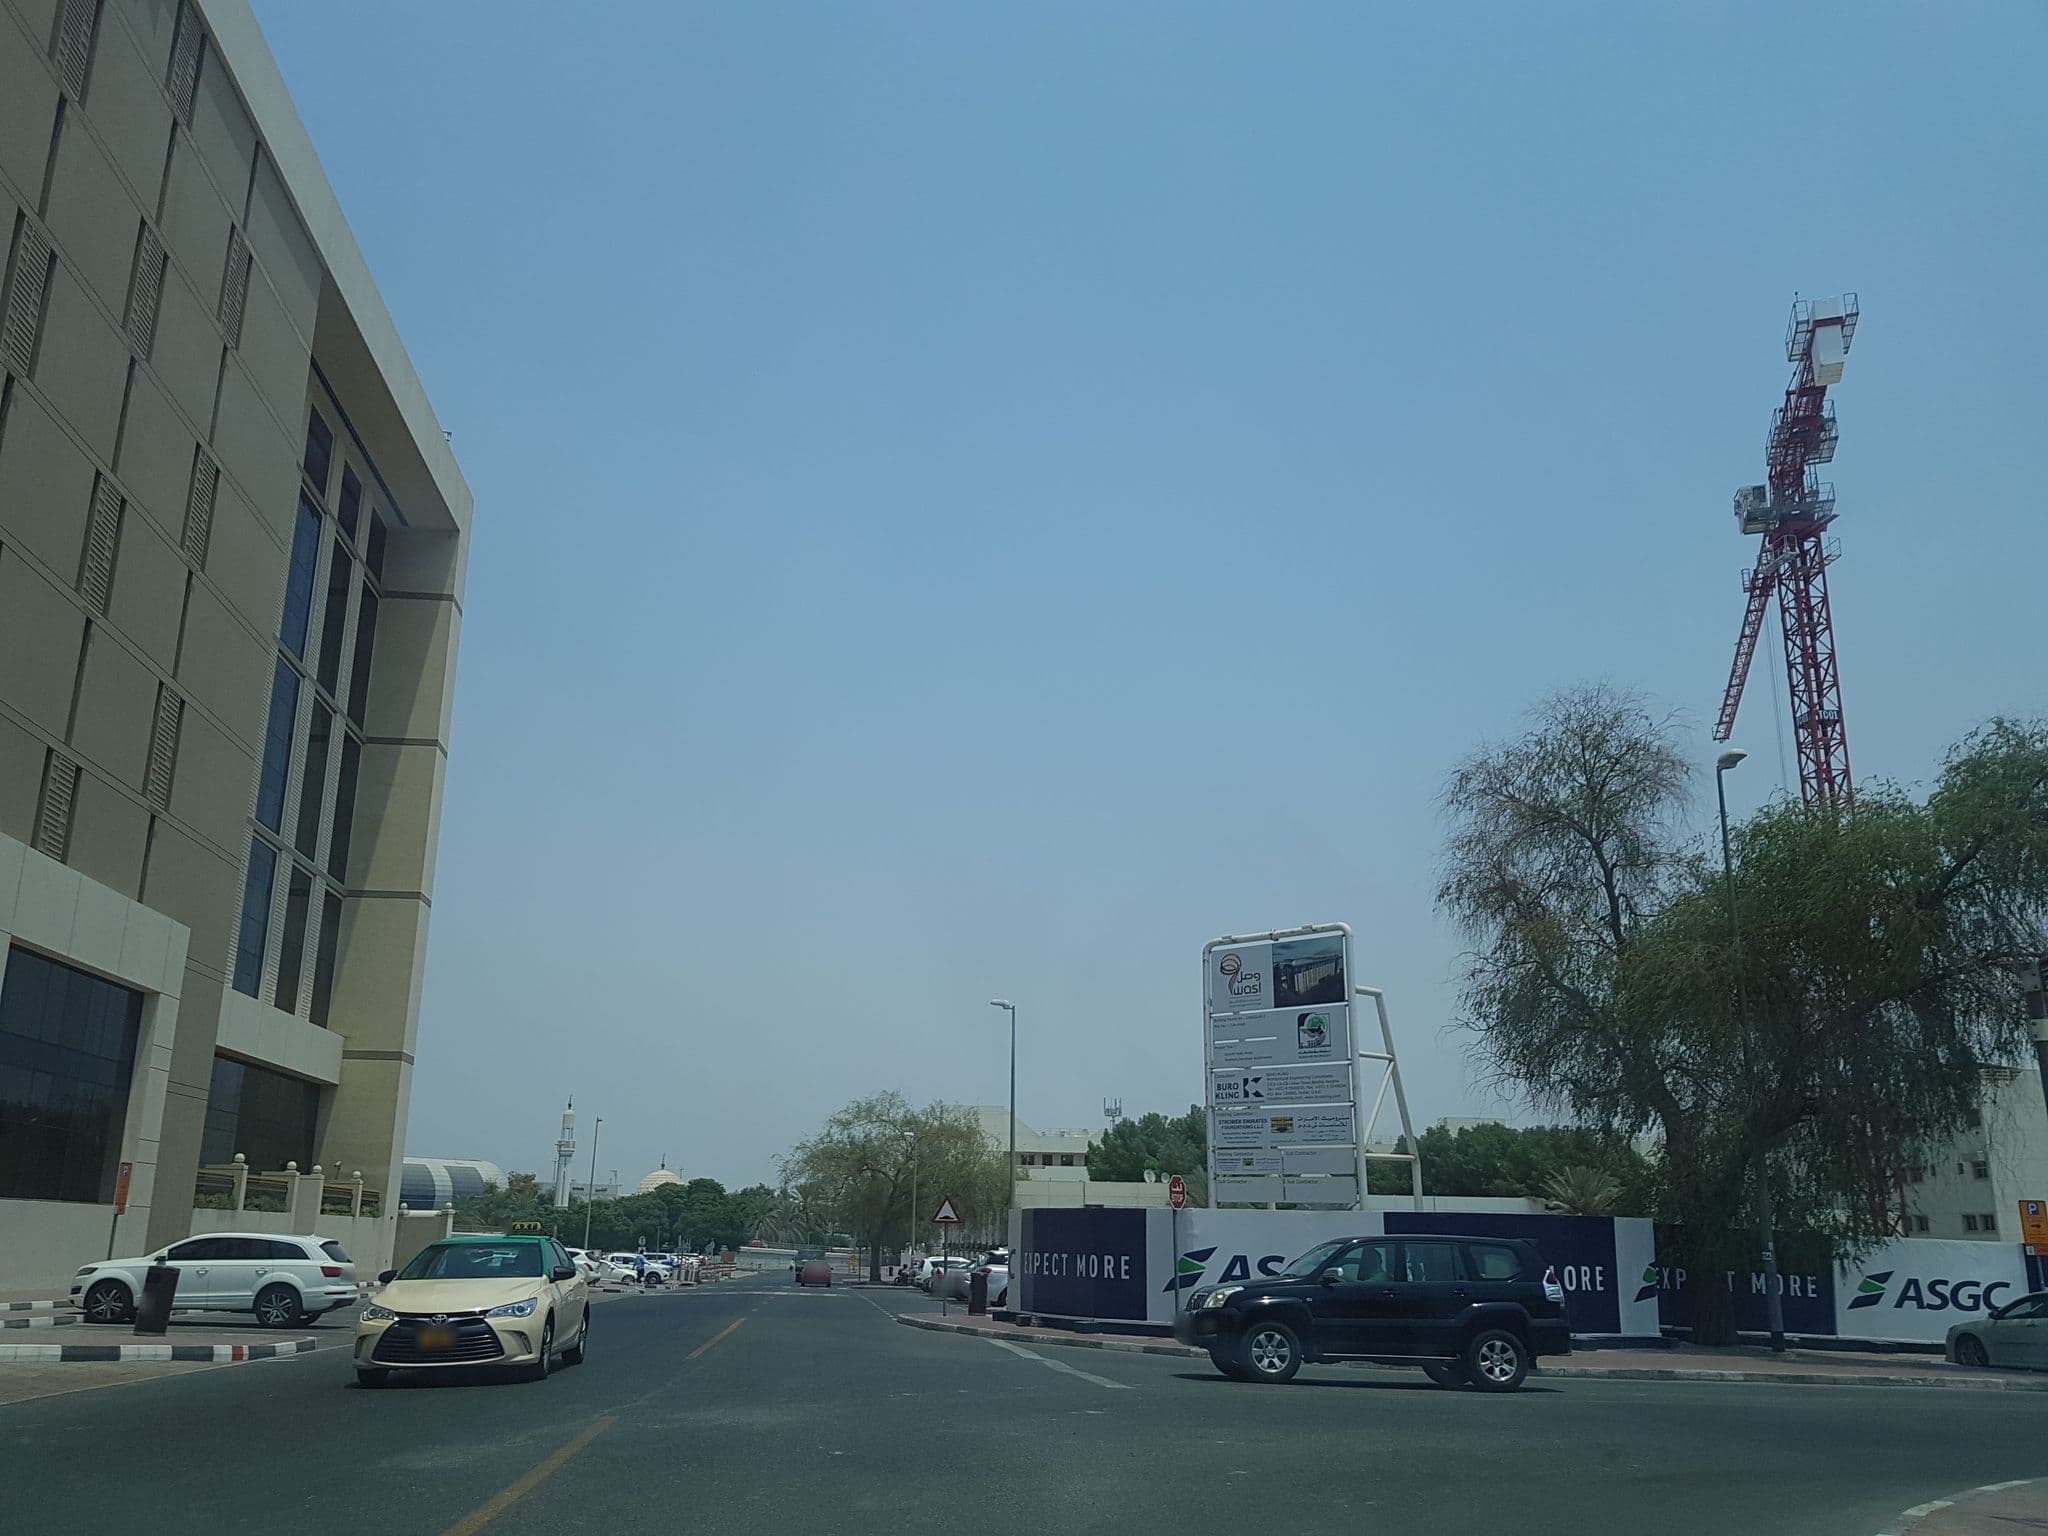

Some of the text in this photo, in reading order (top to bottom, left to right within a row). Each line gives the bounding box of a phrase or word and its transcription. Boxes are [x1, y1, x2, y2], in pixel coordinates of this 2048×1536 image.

[1237, 971, 1261, 983] وصل
[1234, 982, 1261, 995] wasl
[1217, 1082, 1239, 1091] BURO
[1171, 1193, 1184, 1202] STOP
[2027, 1203, 2037, 1215] P
[1024, 1252, 1068, 1277] EXPECT
[1076, 1253, 1130, 1280] MORE
[1217, 1255, 1285, 1284] AS
[1557, 1265, 1604, 1291] ORE
[1892, 1278, 2009, 1311] ASGC
